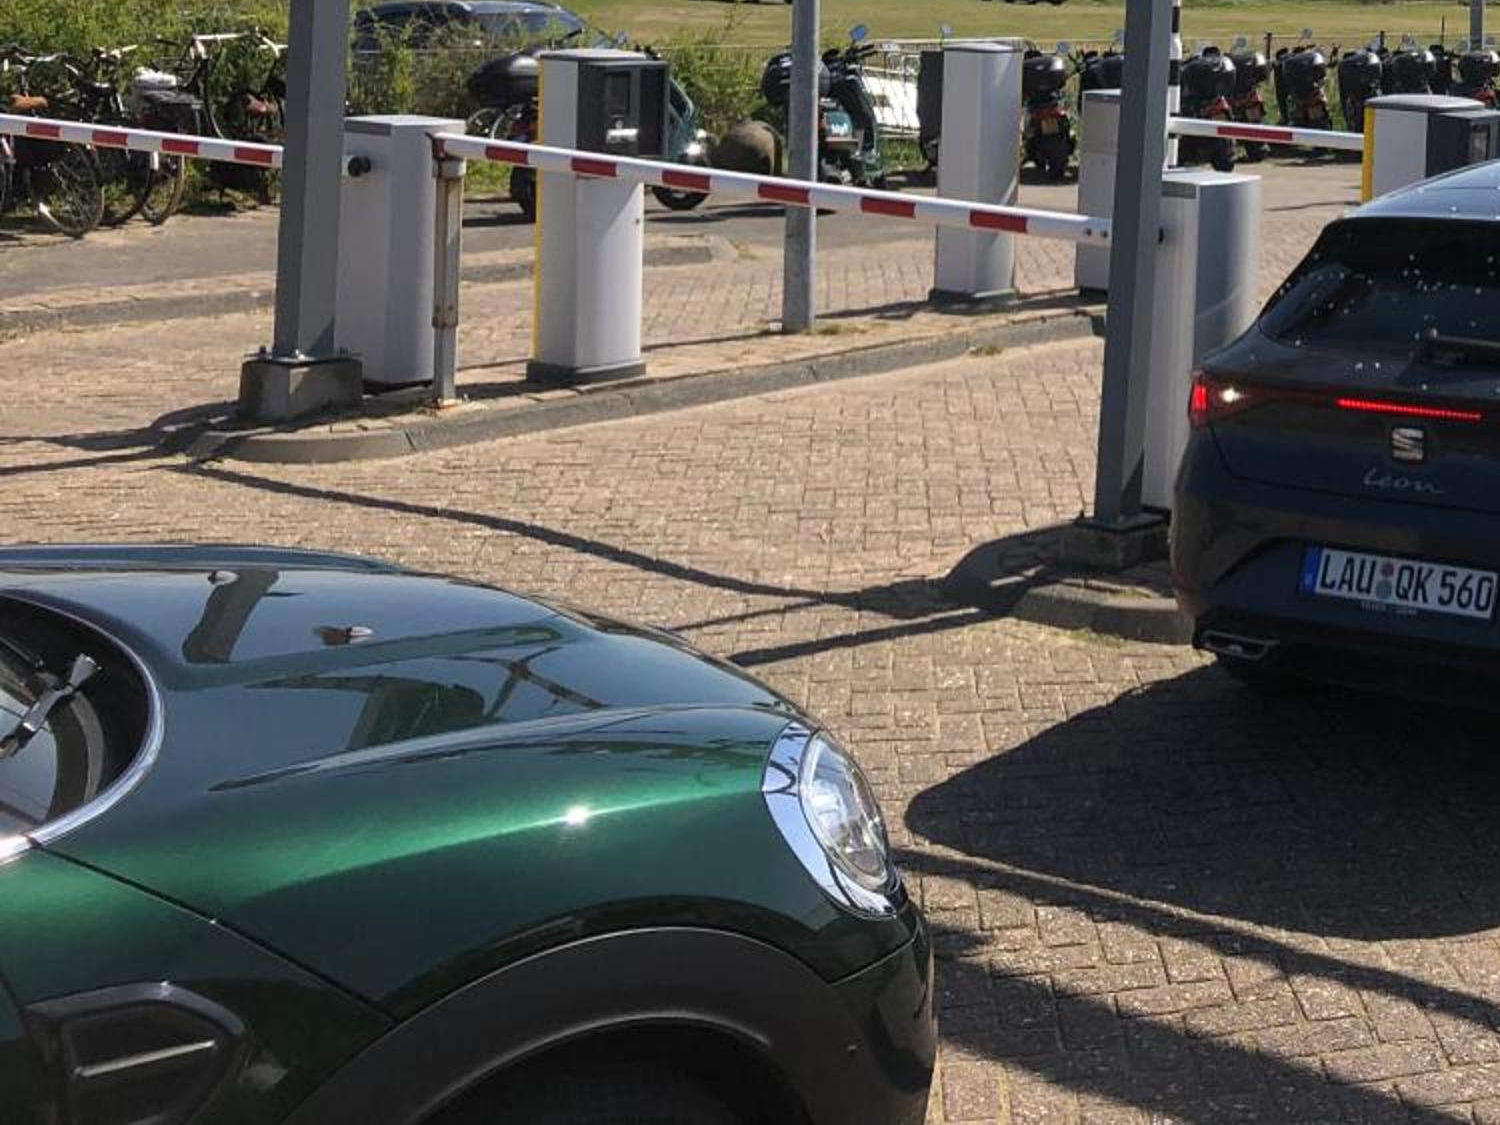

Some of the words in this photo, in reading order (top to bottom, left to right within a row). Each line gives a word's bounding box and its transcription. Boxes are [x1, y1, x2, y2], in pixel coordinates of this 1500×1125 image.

[1363, 467, 1444, 493] Leon
[1320, 554, 1377, 594] LAU
[1395, 565, 1434, 603] QK
[1438, 571, 1493, 612] 560
